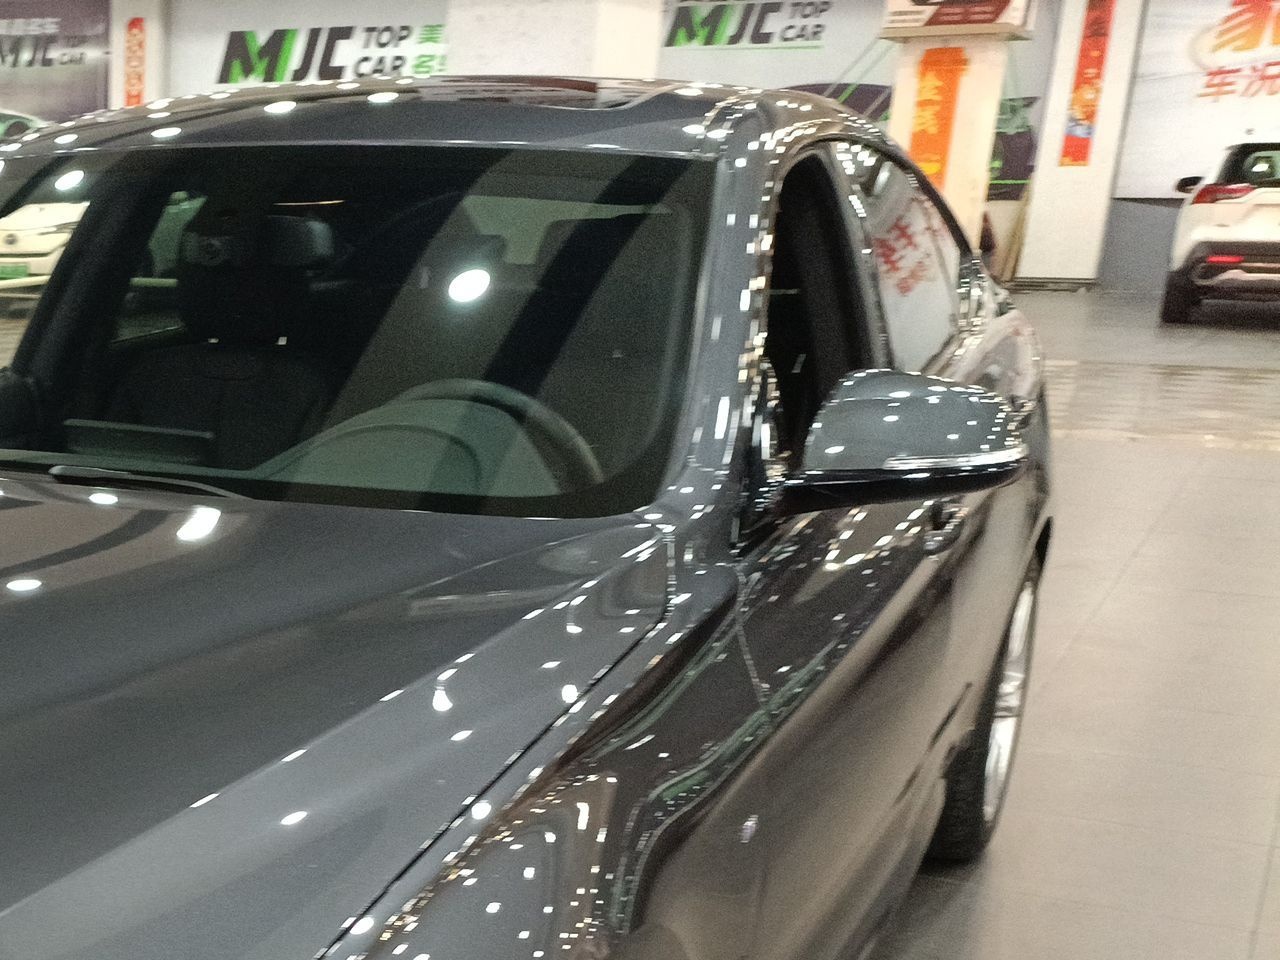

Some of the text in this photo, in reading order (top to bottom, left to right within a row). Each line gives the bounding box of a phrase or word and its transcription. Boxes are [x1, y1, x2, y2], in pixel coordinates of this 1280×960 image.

[664, 2, 783, 47] MJC
[216, 26, 411, 84] MJC TOP
[354, 56, 405, 78] CAR
